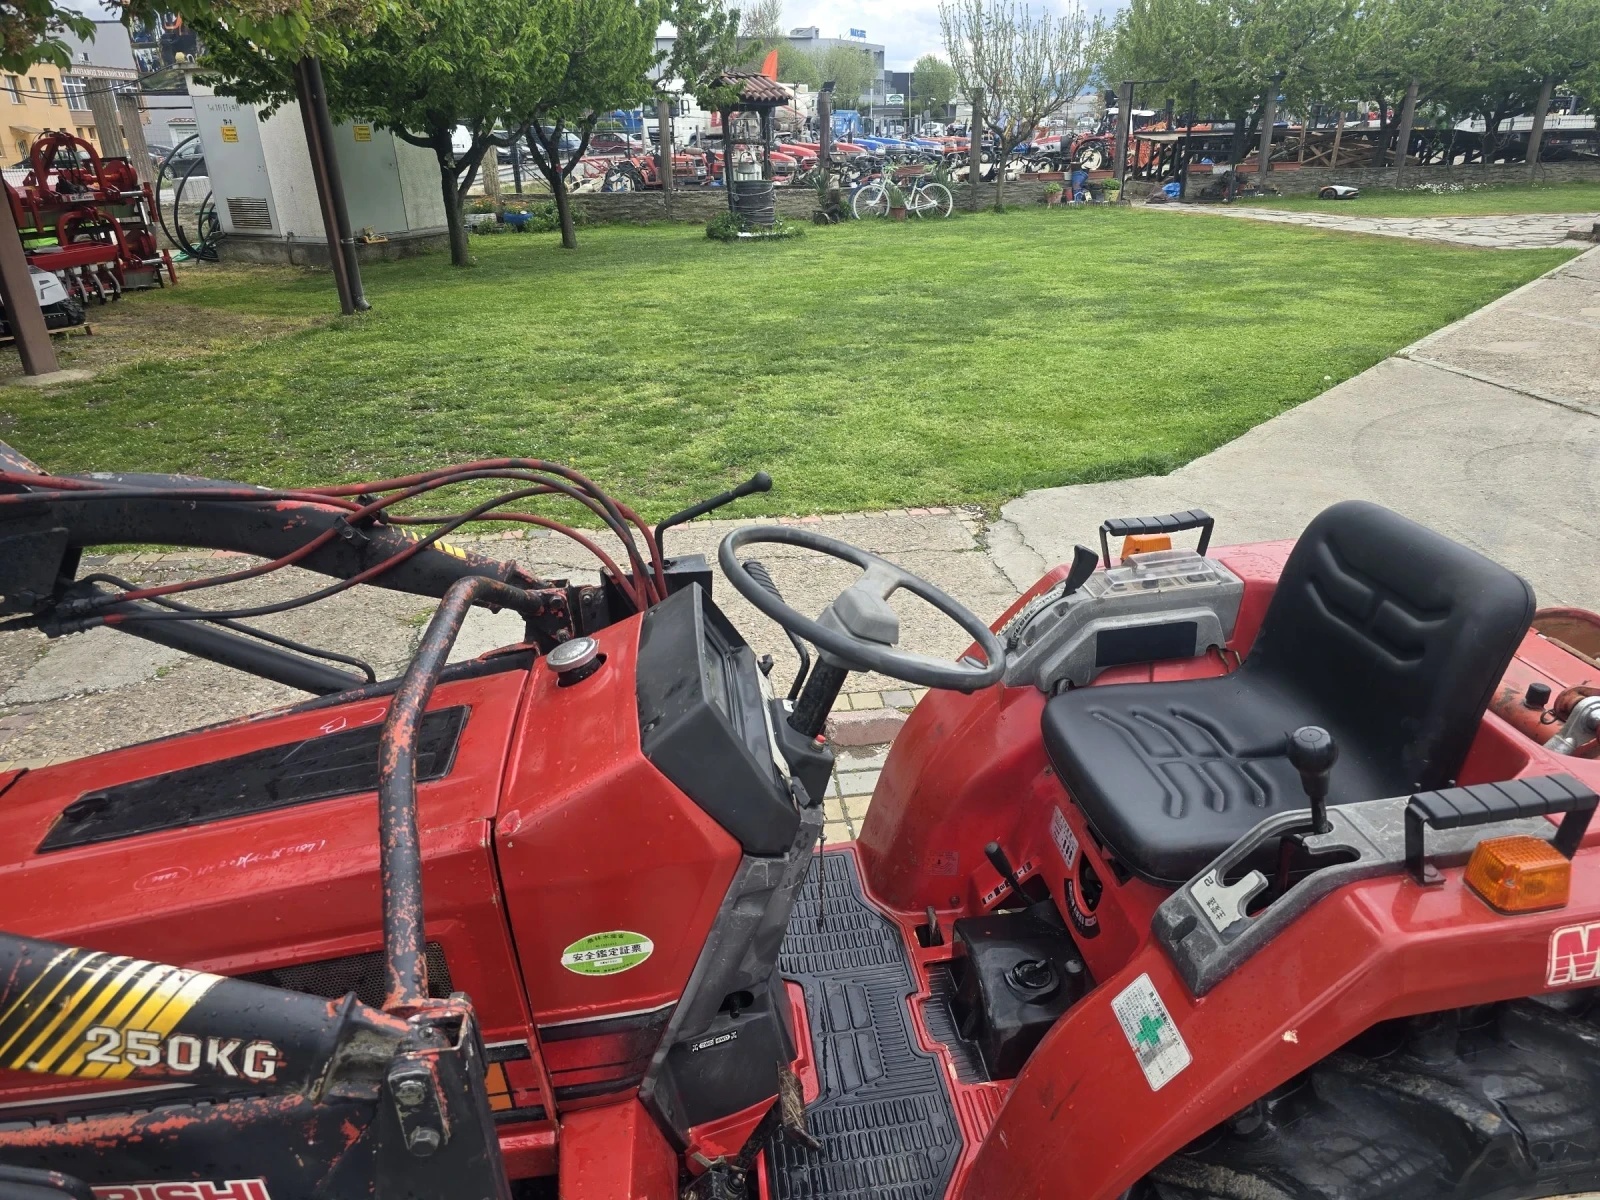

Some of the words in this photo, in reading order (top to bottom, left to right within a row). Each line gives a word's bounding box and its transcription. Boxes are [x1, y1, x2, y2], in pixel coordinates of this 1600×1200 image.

[572, 943, 643, 962] 安全鑑定証票
[85, 1025, 278, 1080] 250KG
